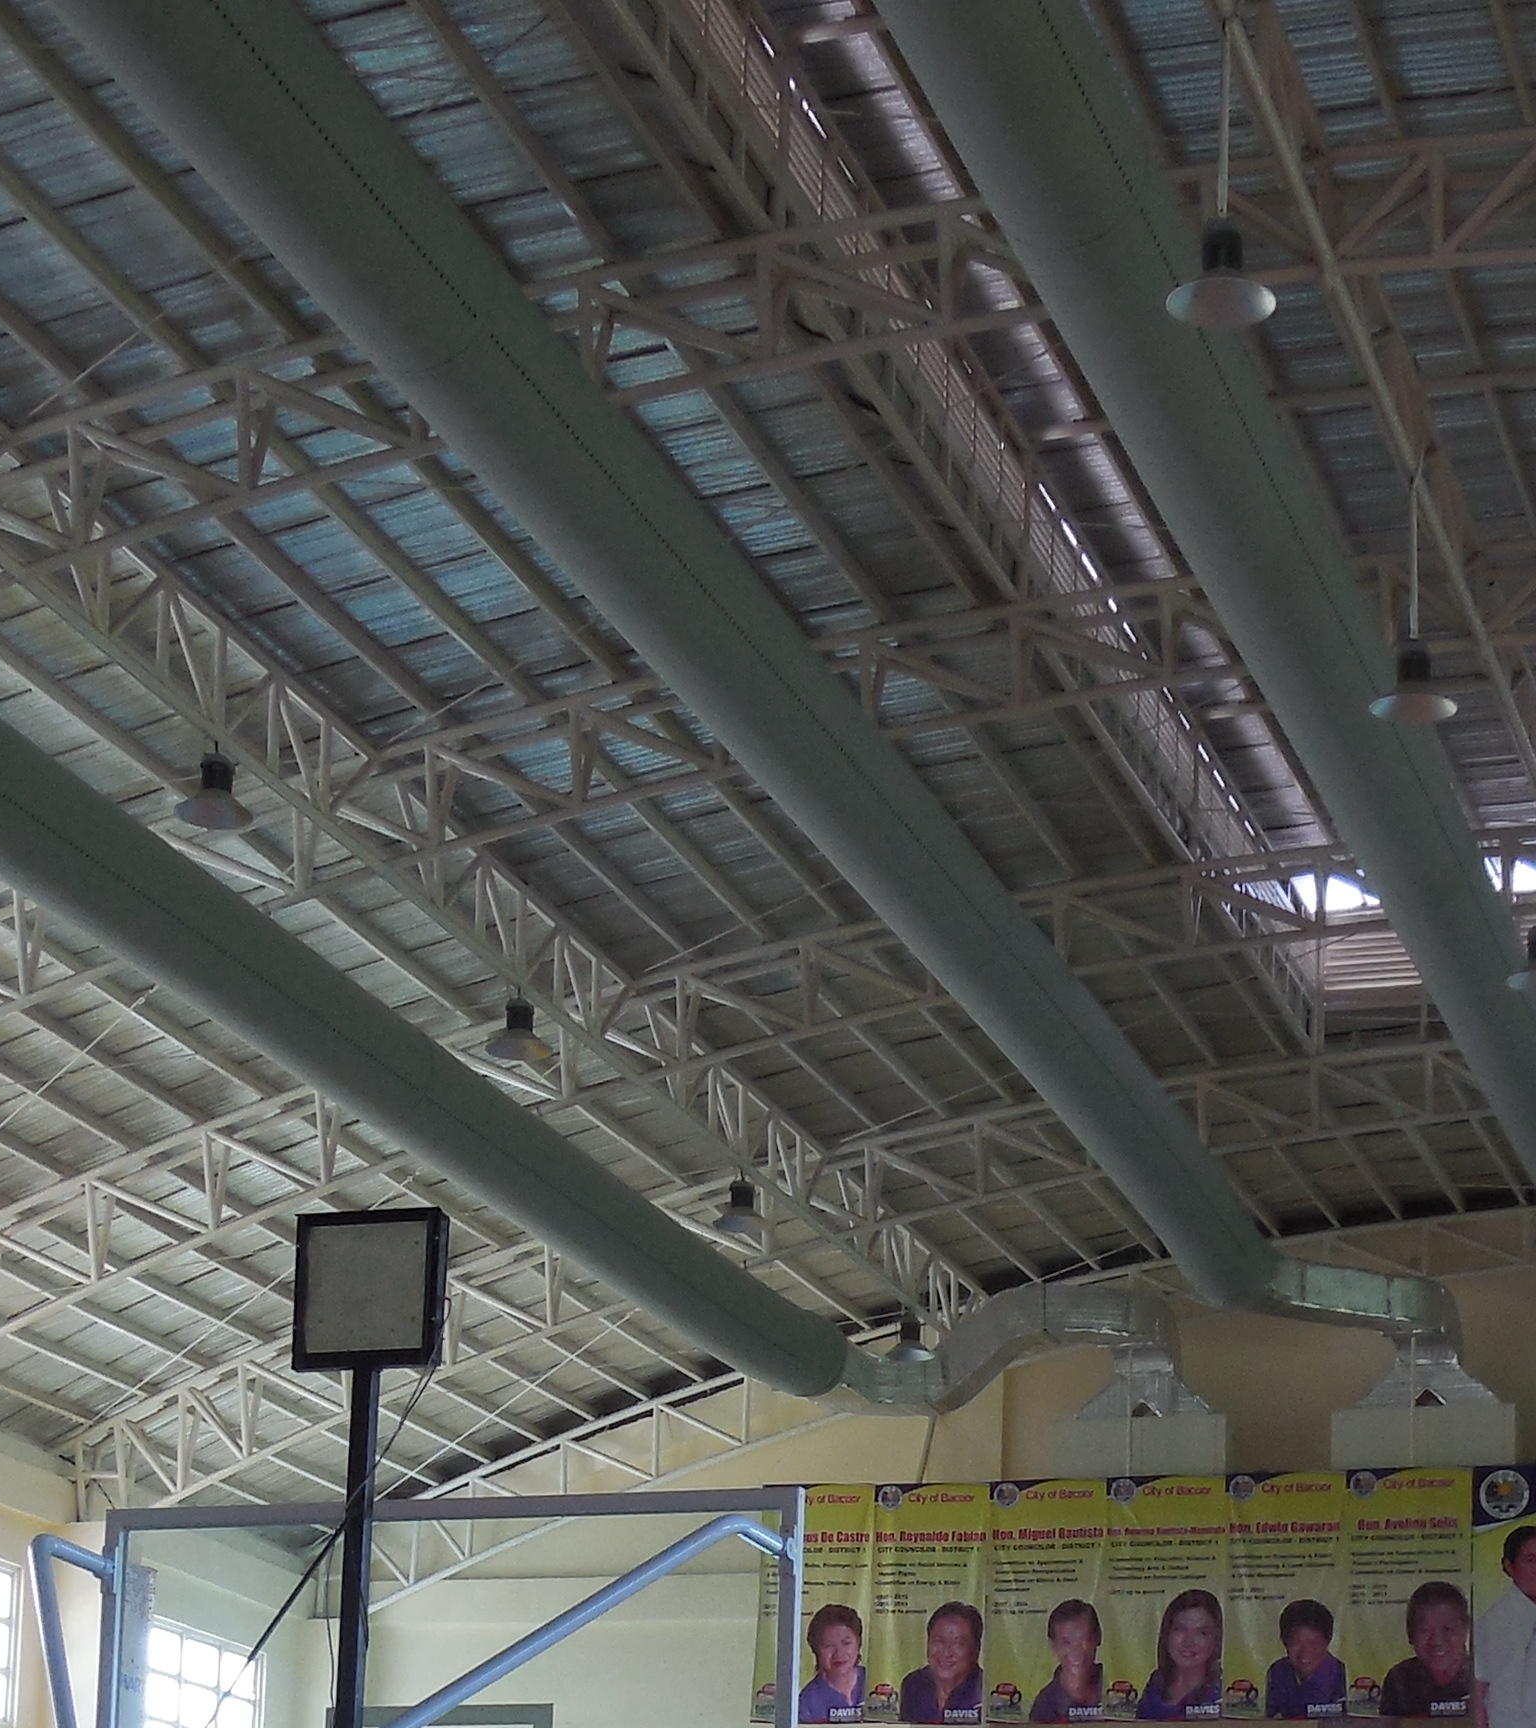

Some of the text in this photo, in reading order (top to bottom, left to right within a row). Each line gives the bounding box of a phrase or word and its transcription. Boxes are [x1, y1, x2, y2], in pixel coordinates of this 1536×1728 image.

[1261, 1482, 1331, 1495] City of Bacoor
[1383, 1478, 1455, 1491] City of Bacoor
[1025, 1489, 1094, 1503] City of Bacoor
[1142, 1485, 1211, 1498] City of Bacoor
[908, 1493, 975, 1506] City of Bacoor
[876, 1531, 897, 1542] Hon.
[951, 1531, 986, 1542] Fabian
[1019, 1528, 1056, 1541] Miguel
[944, 1707, 979, 1718] DAVIES
[1068, 1706, 1103, 1717] DAVIES
[1185, 1704, 1220, 1715] DAVIES
[1430, 1702, 1466, 1712] DAVIES
